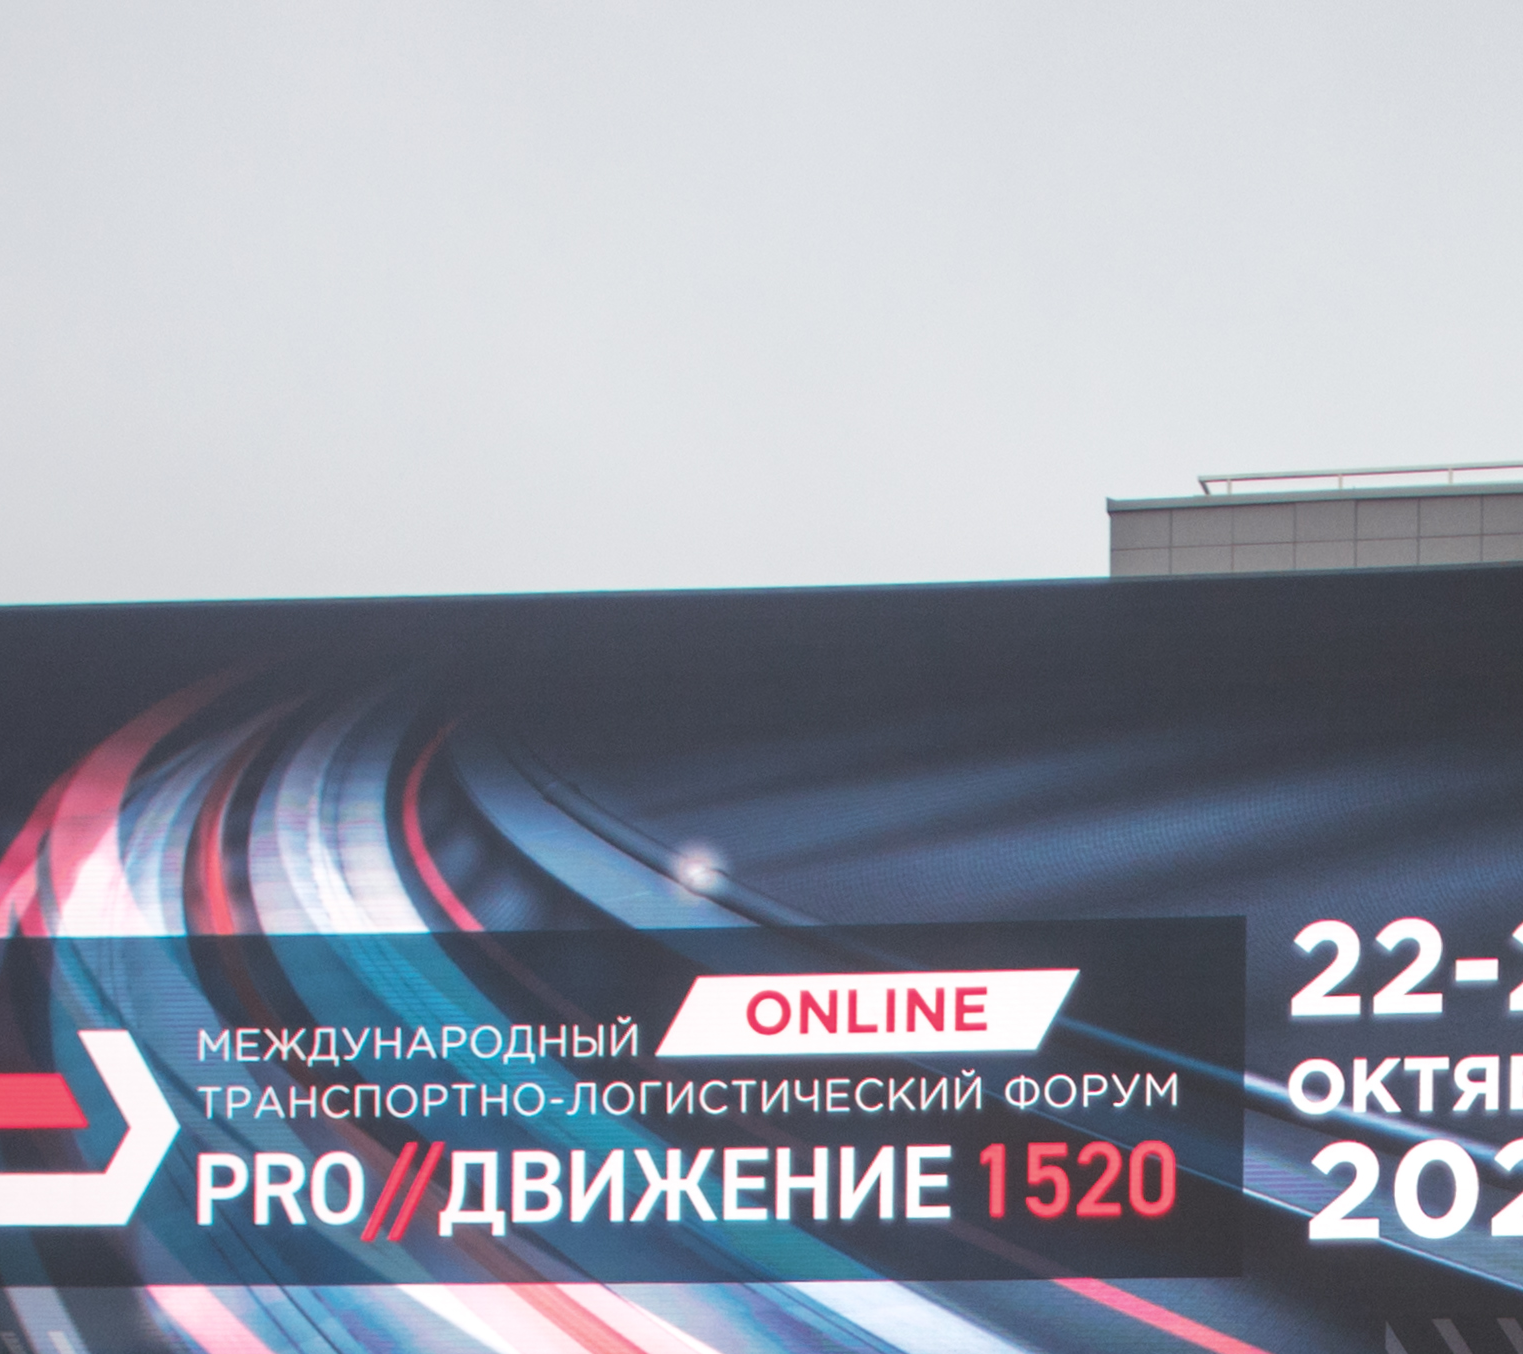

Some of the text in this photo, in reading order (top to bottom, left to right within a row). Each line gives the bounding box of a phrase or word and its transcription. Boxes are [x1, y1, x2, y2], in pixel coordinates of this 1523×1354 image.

[746, 987, 989, 1036] ONLINE
[197, 1016, 640, 1067] МЕЖДУНАРОДНЫЙ
[197, 1069, 1179, 1120] ТРАНСПОРТНО-ЛОГИСТИЧЕСКИЙ ФОРУМ
[979, 1140, 1177, 1220] 1520
